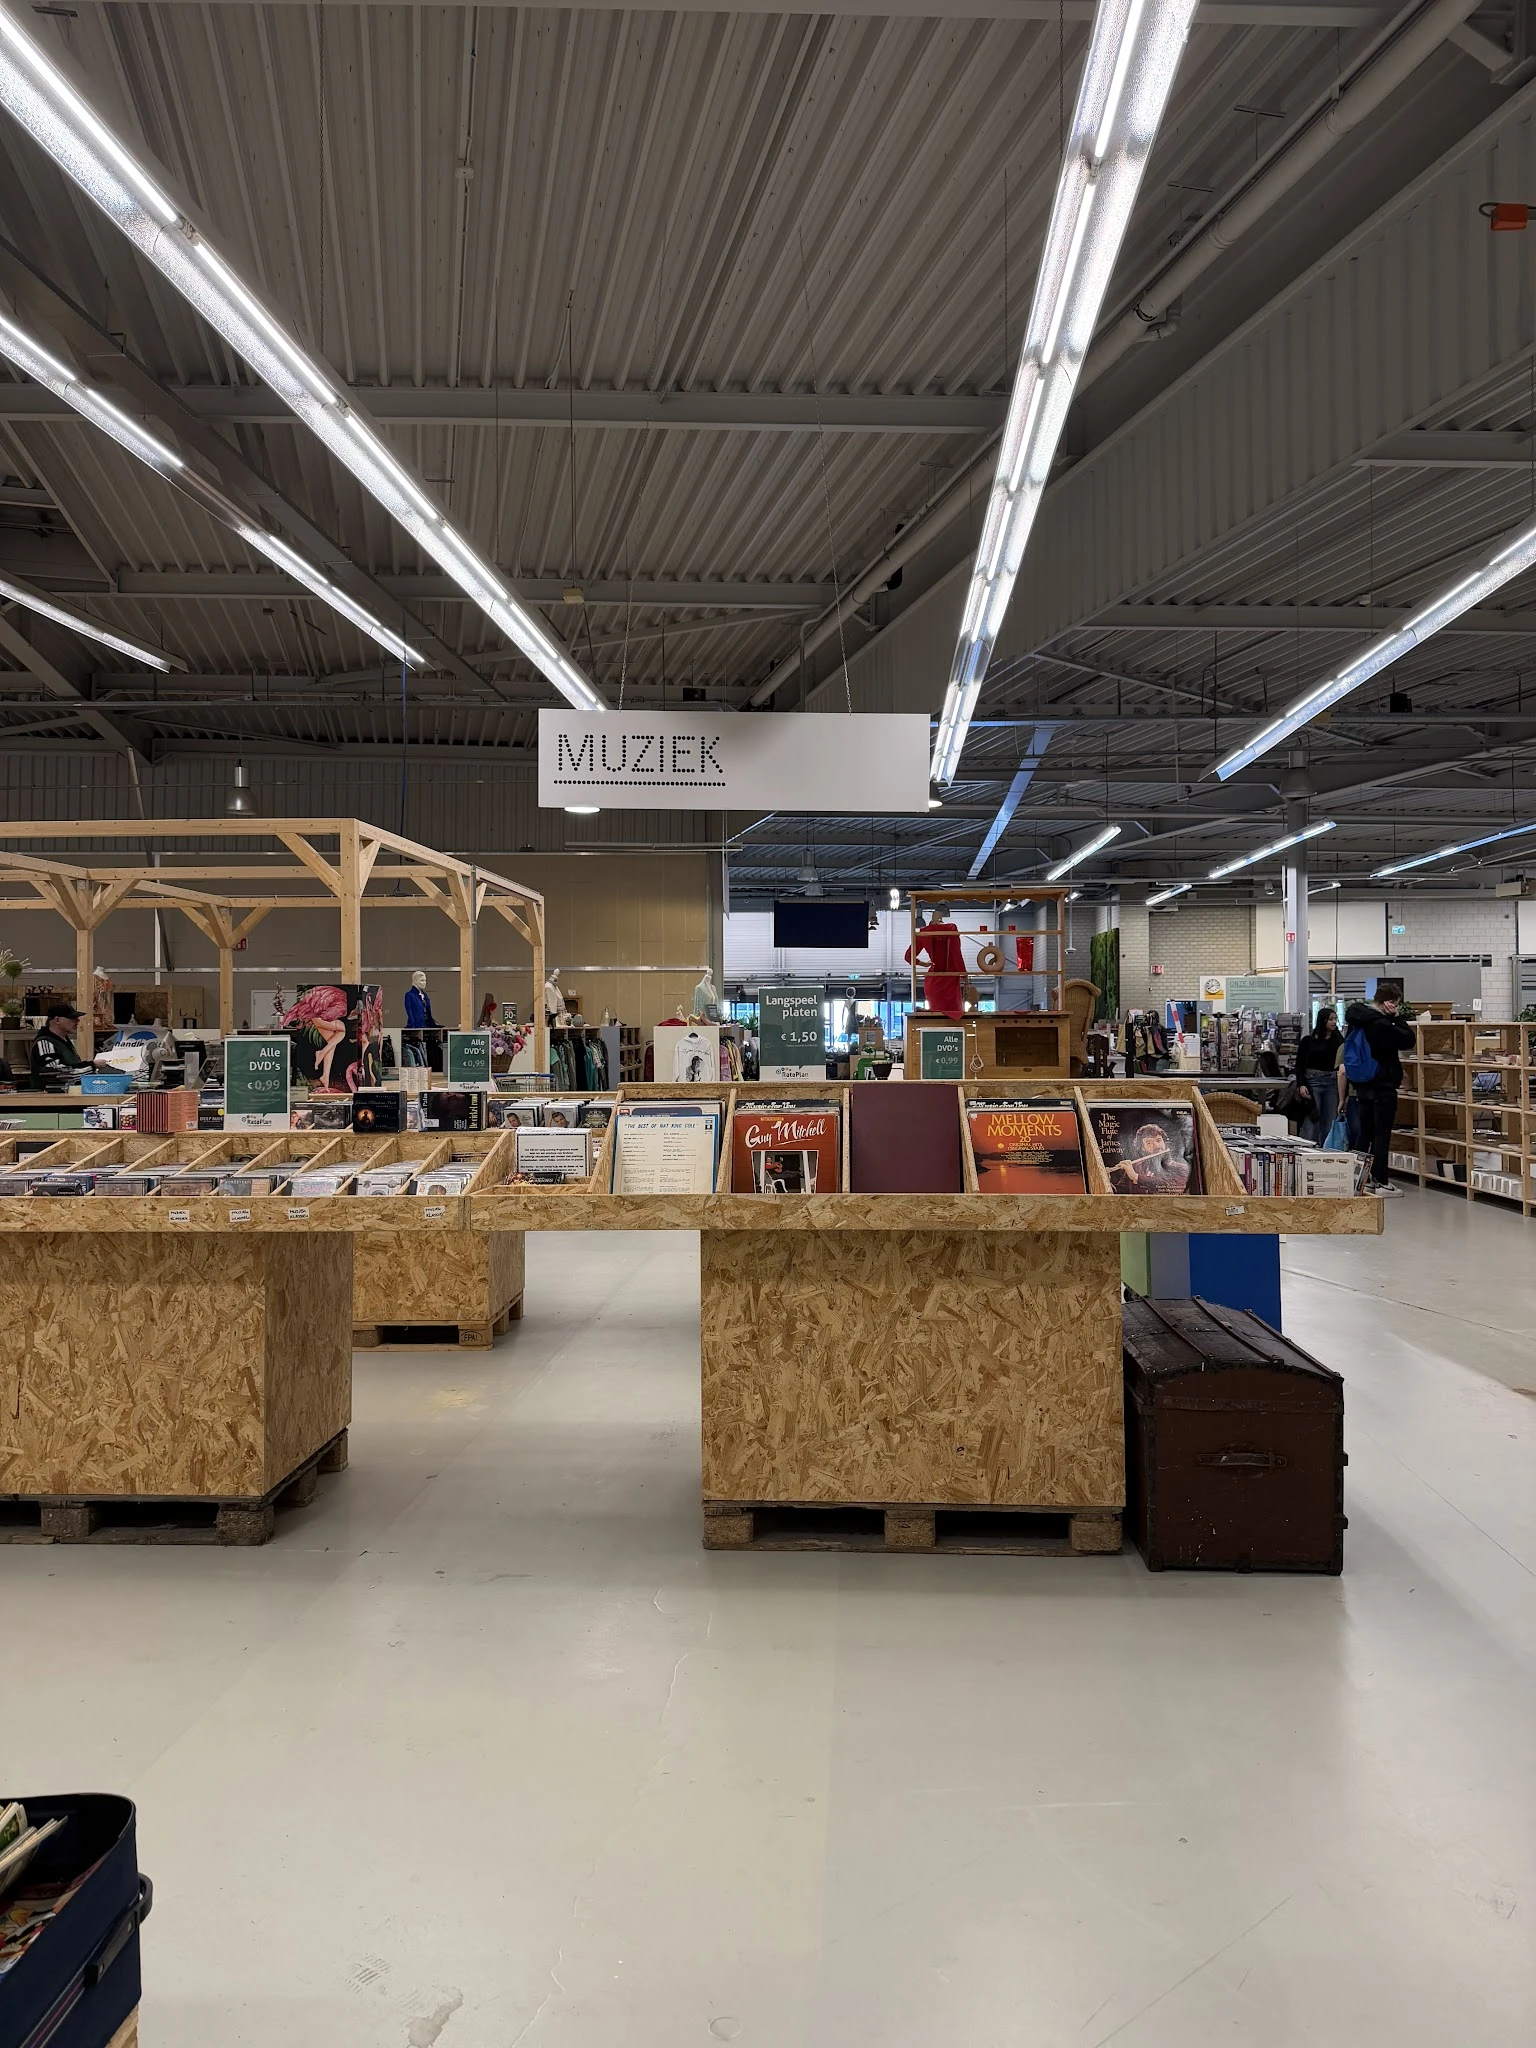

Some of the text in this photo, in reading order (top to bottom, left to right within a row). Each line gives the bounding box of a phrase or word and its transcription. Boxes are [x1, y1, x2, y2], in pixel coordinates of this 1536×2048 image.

[558, 734, 723, 773] MUZIEK
[766, 995, 818, 1007] Langspeel
[782, 1007, 818, 1019] platen
[470, 1038, 485, 1046] Alle
[790, 1031, 818, 1043] 1,50
[259, 1048, 281, 1057] Alle
[464, 1047, 485, 1055] DVD's
[936, 1044, 959, 1052] DVD's
[249, 1061, 281, 1071] DVD's
[254, 1080, 281, 1092] 0,99
[991, 1113, 1056, 1126] MELLOW
[1100, 1112, 1116, 1120] The
[1098, 1120, 1120, 1130] Magic
[744, 1118, 828, 1148] Guy Mitchell
[987, 1124, 1062, 1137] MOMENTS
[1101, 1127, 1118, 1135] Flute
[1100, 1139, 1121, 1149] James
